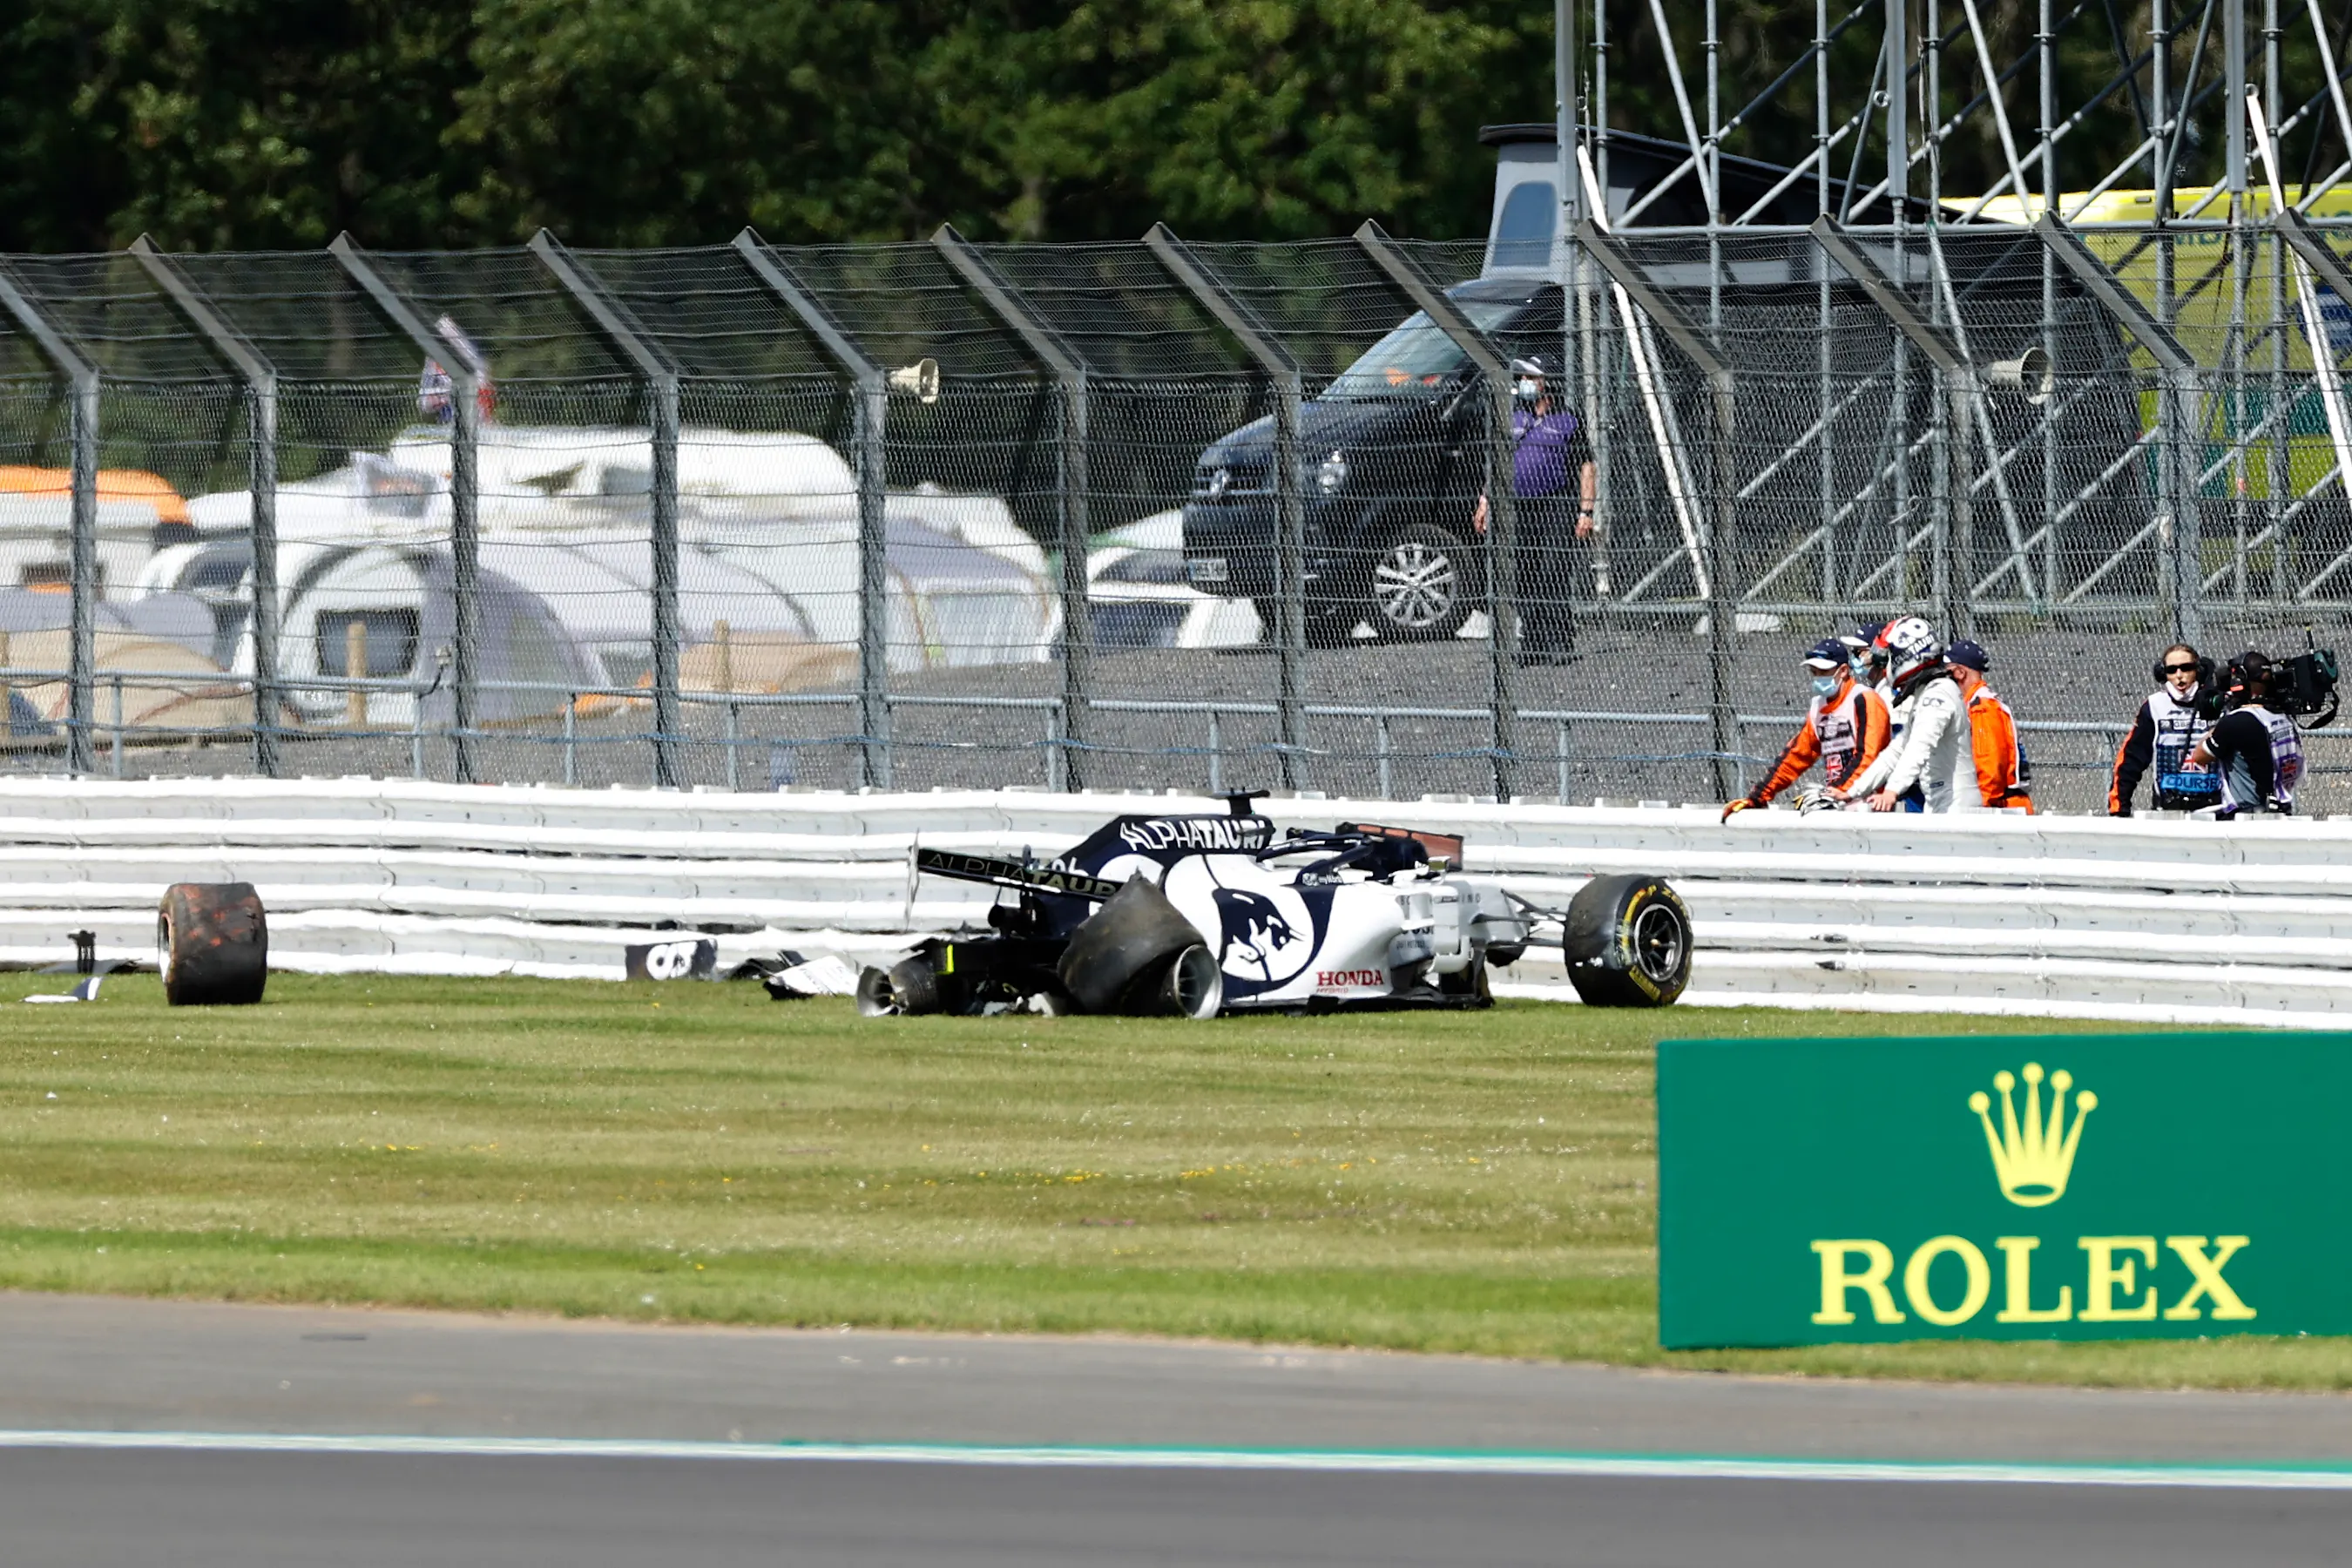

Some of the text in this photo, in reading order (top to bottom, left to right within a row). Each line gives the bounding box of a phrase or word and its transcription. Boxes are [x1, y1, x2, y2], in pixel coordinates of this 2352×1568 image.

[2167, 776, 2217, 790] COURSE
[1119, 819, 1266, 851] ALPHATAURI
[927, 853, 1118, 896] ALPHATAUR
[1316, 969, 1385, 986] HONDA
[1810, 1234, 2257, 1327] ROLEX
